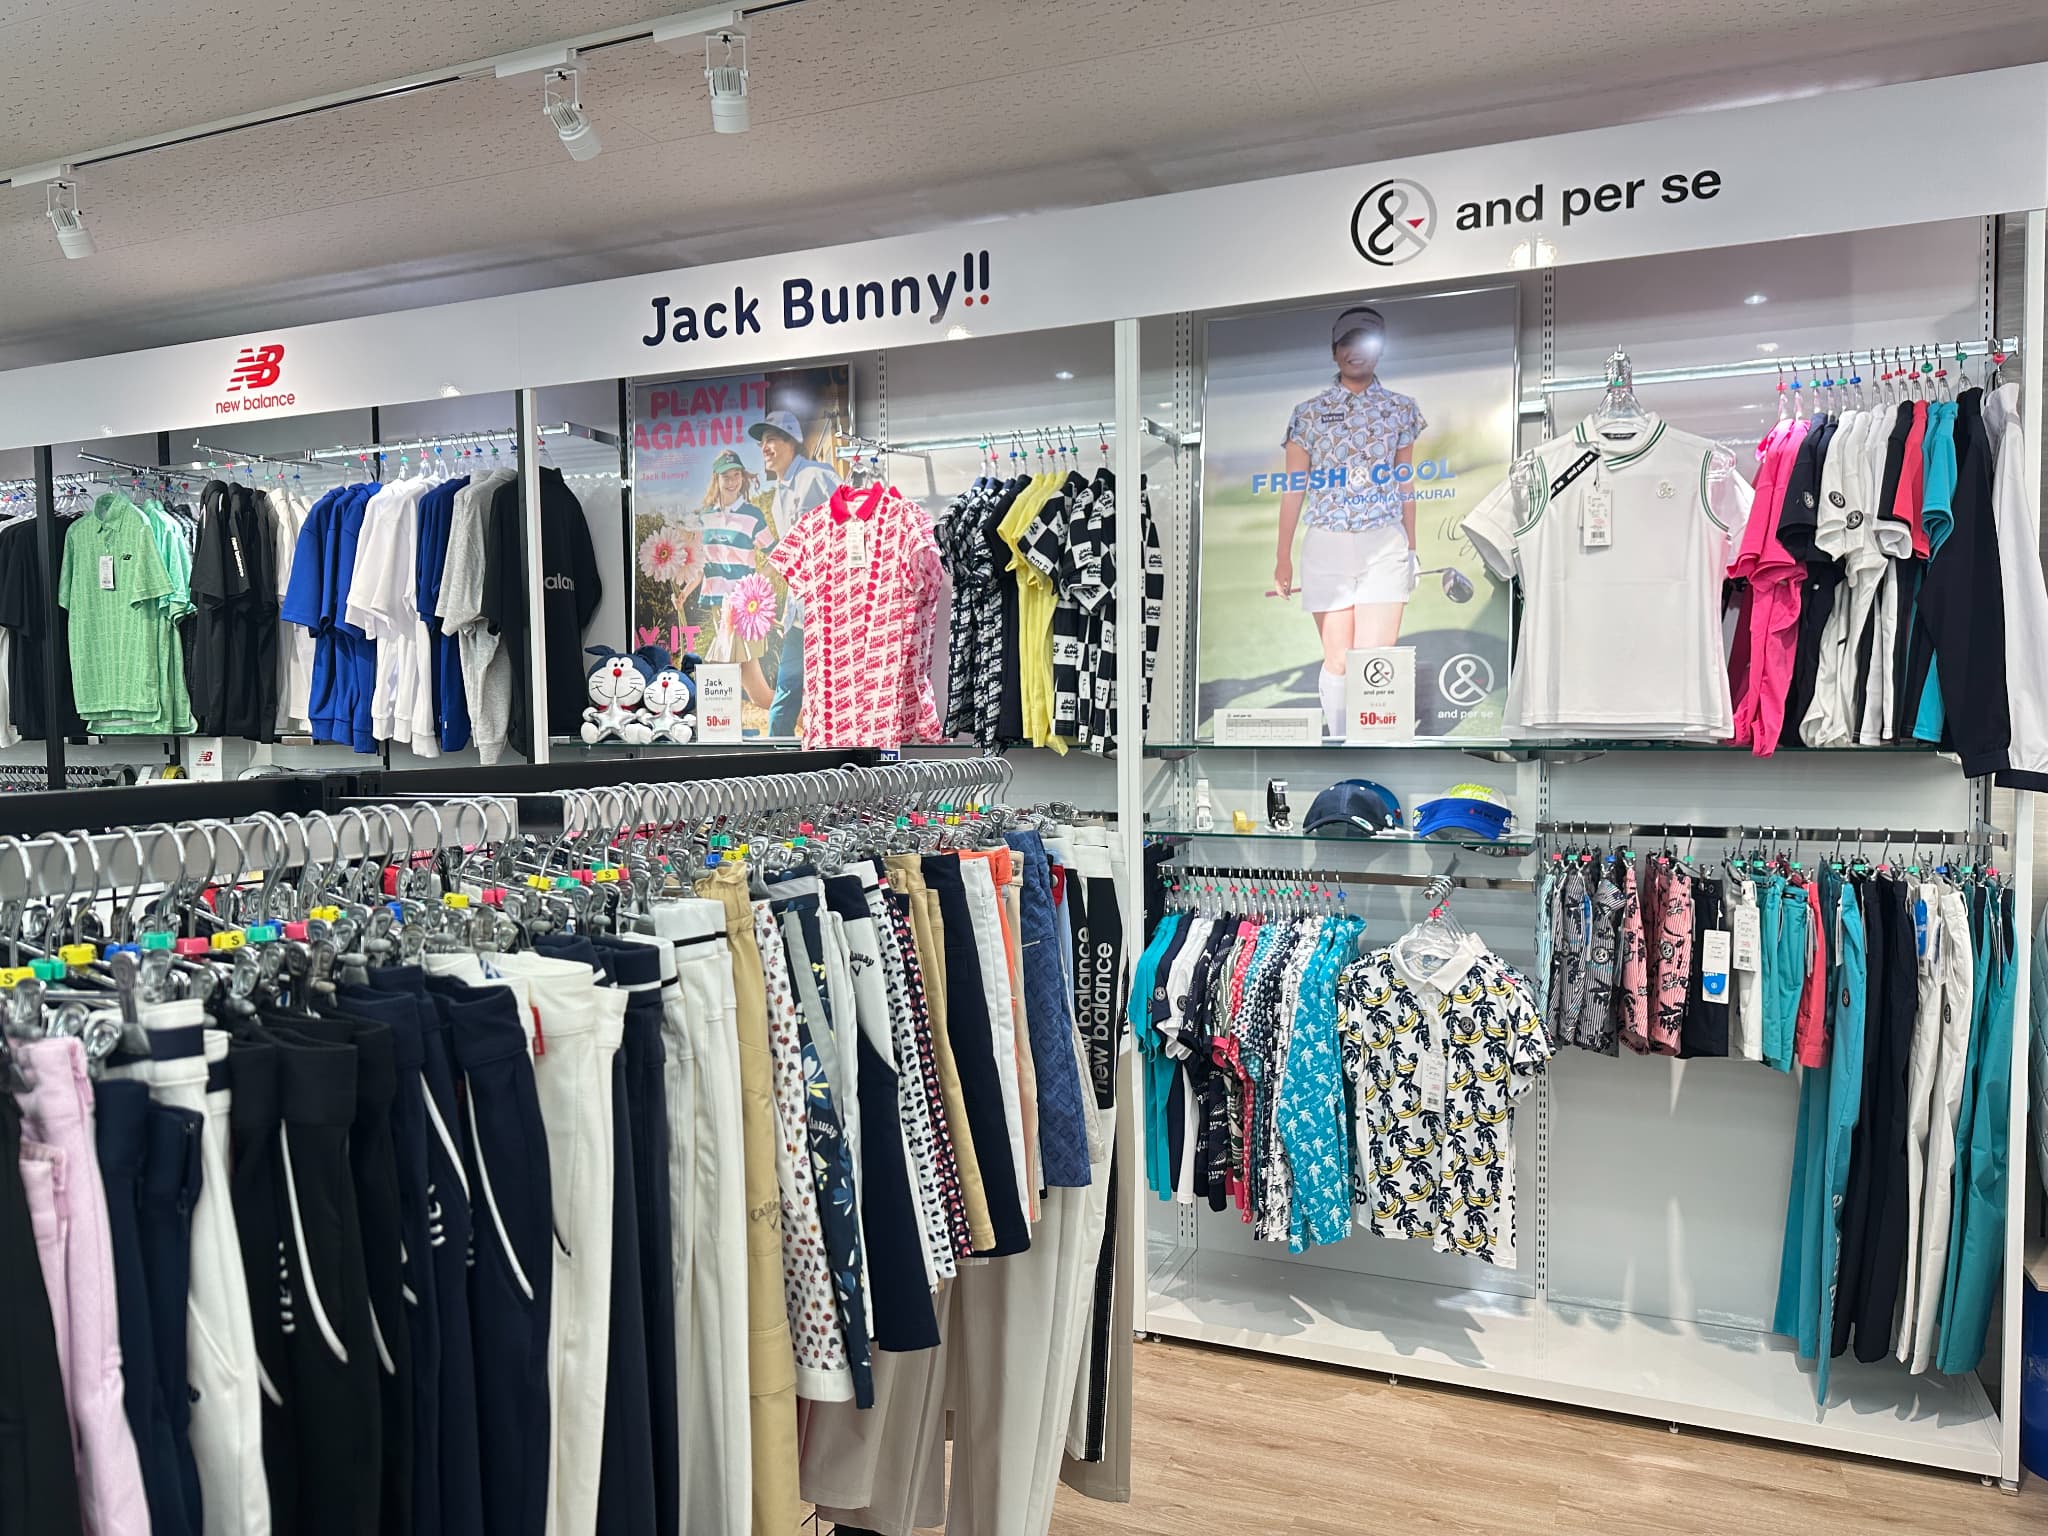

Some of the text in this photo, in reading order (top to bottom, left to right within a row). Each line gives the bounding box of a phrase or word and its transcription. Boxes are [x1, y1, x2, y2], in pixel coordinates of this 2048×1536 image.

[1456, 184, 1543, 231] and
[1562, 179, 1645, 226] per
[1661, 169, 1721, 203] se
[642, 250, 990, 346] Jack Bunny!!
[215, 393, 296, 414] new balance
[651, 381, 770, 420] PLAY IT
[1252, 467, 1346, 494] FRESH
[1371, 458, 1457, 486] COOL
[1399, 488, 1456, 501] SAKURAI
[704, 678, 722, 687] Jack
[1360, 711, 1397, 726] 50%OFF
[1438, 709, 1458, 719] and
[605, 871, 611, 879] S
[446, 896, 452, 905] S
[184, 942, 192, 953] L
[232, 935, 239, 946] S
[4, 972, 13, 984] S
[1075, 926, 1092, 1027] balance
[1091, 942, 1113, 1041] balance
[1092, 1045, 1109, 1094] new
